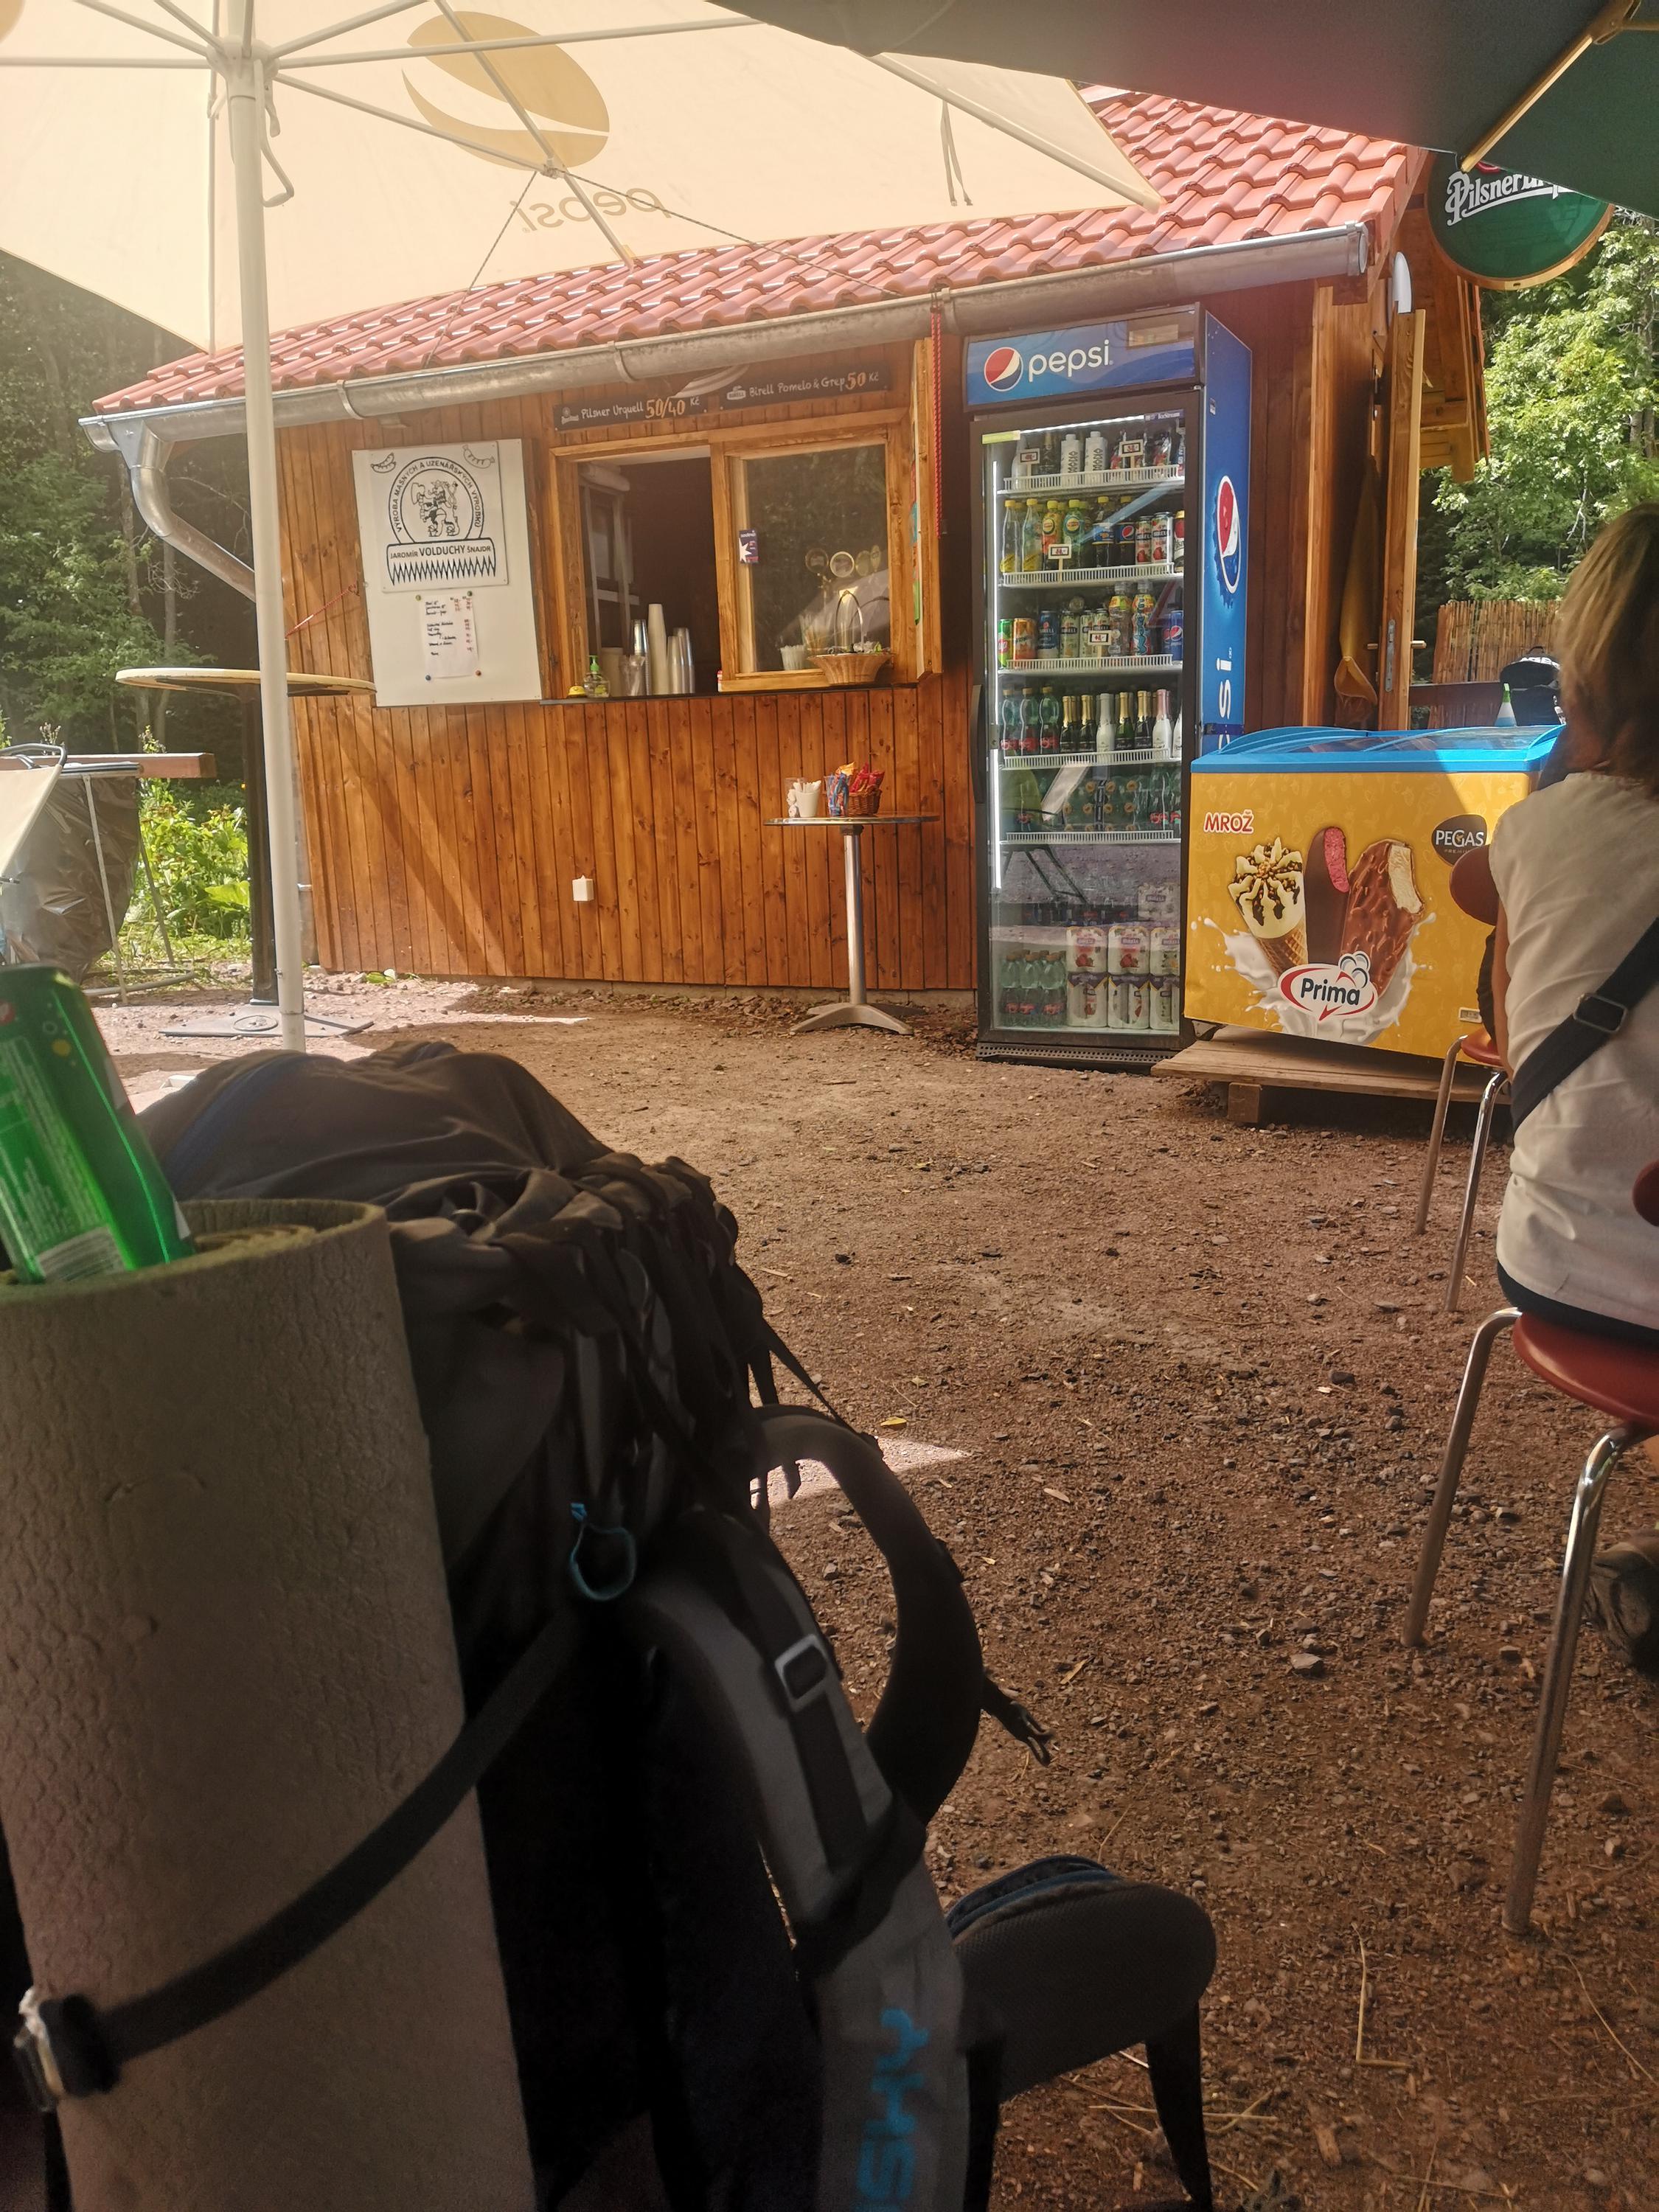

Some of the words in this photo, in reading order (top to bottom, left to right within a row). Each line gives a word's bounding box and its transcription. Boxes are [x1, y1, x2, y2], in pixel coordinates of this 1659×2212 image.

[1028, 338, 1110, 383] pepsi
[749, 384, 774, 397] Birell
[778, 380, 811, 394] Pomelo
[813, 378, 820, 389] &
[821, 377, 846, 391] Grep
[845, 372, 866, 390] 50
[869, 371, 880, 382] Kč
[581, 408, 610, 420] Pilsner
[613, 402, 644, 419] Urquell
[645, 398, 686, 420] 50/40
[689, 397, 700, 407] Kč
[390, 551, 418, 560] JAROMÍR
[419, 545, 465, 557] VOLDUCHY
[1204, 810, 1253, 833] MROŽ
[1435, 830, 1484, 848] PEGAS
[1301, 978, 1360, 1007] Prima
